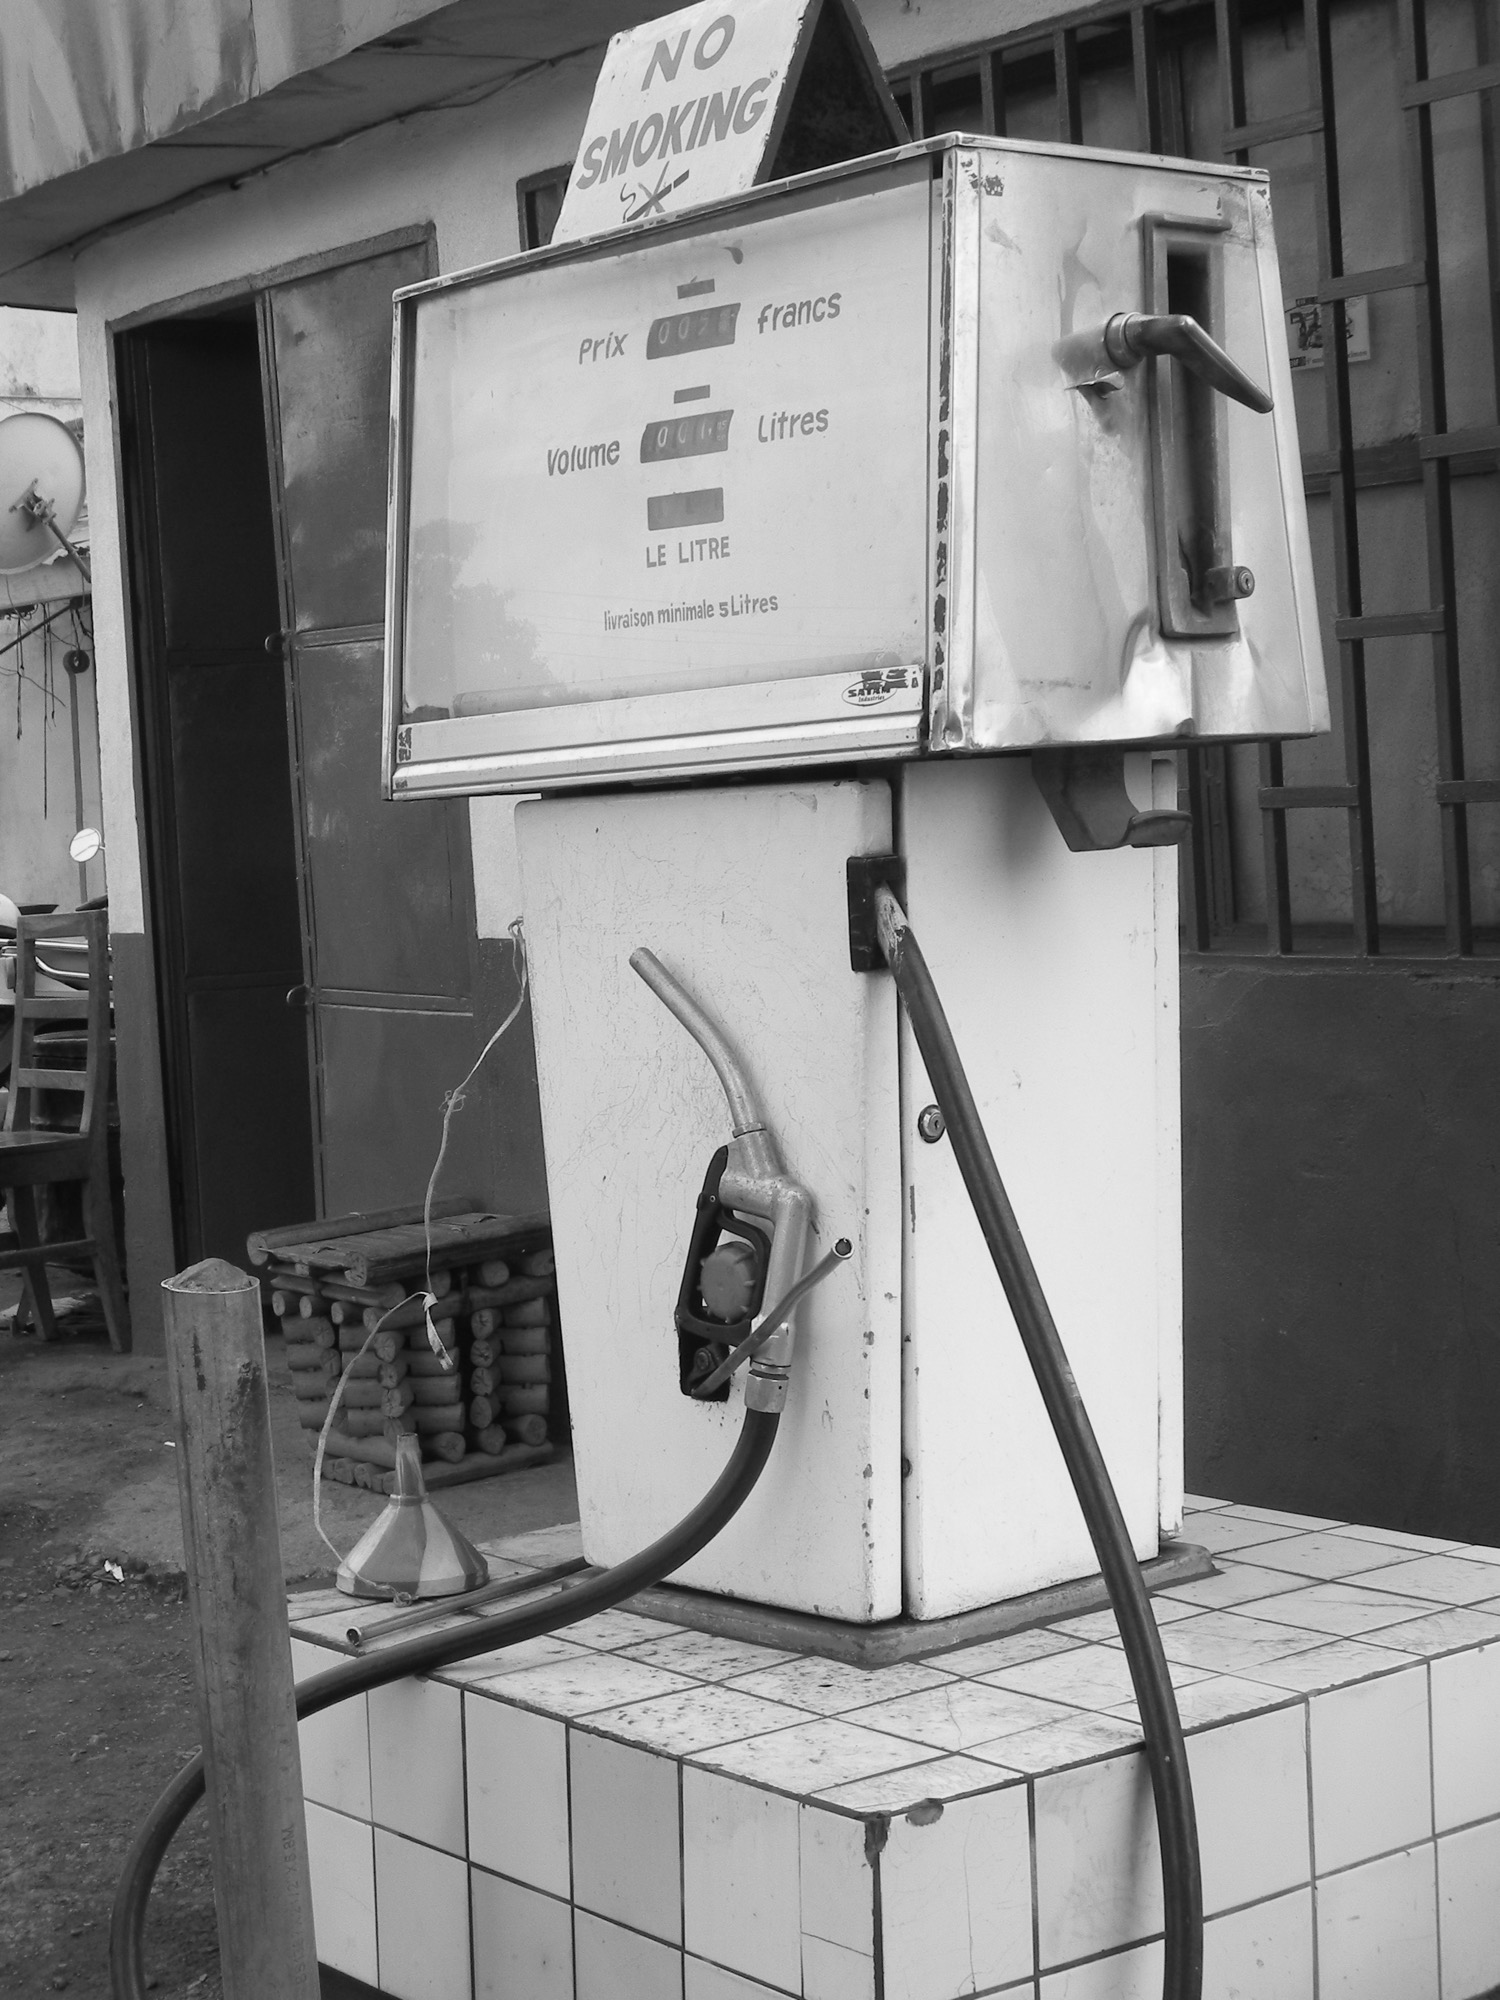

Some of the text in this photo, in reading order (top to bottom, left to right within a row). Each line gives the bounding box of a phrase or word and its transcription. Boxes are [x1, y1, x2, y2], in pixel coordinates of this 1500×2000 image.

[641, 14, 736, 92] NO
[576, 77, 771, 190] SMOKING
[578, 331, 629, 365] Prix
[757, 292, 842, 334] francs
[547, 440, 620, 476] Volume
[758, 408, 829, 443] Litres
[646, 536, 731, 568] LE LITRE
[604, 608, 654, 631] livraison
[657, 599, 714, 624] minimale
